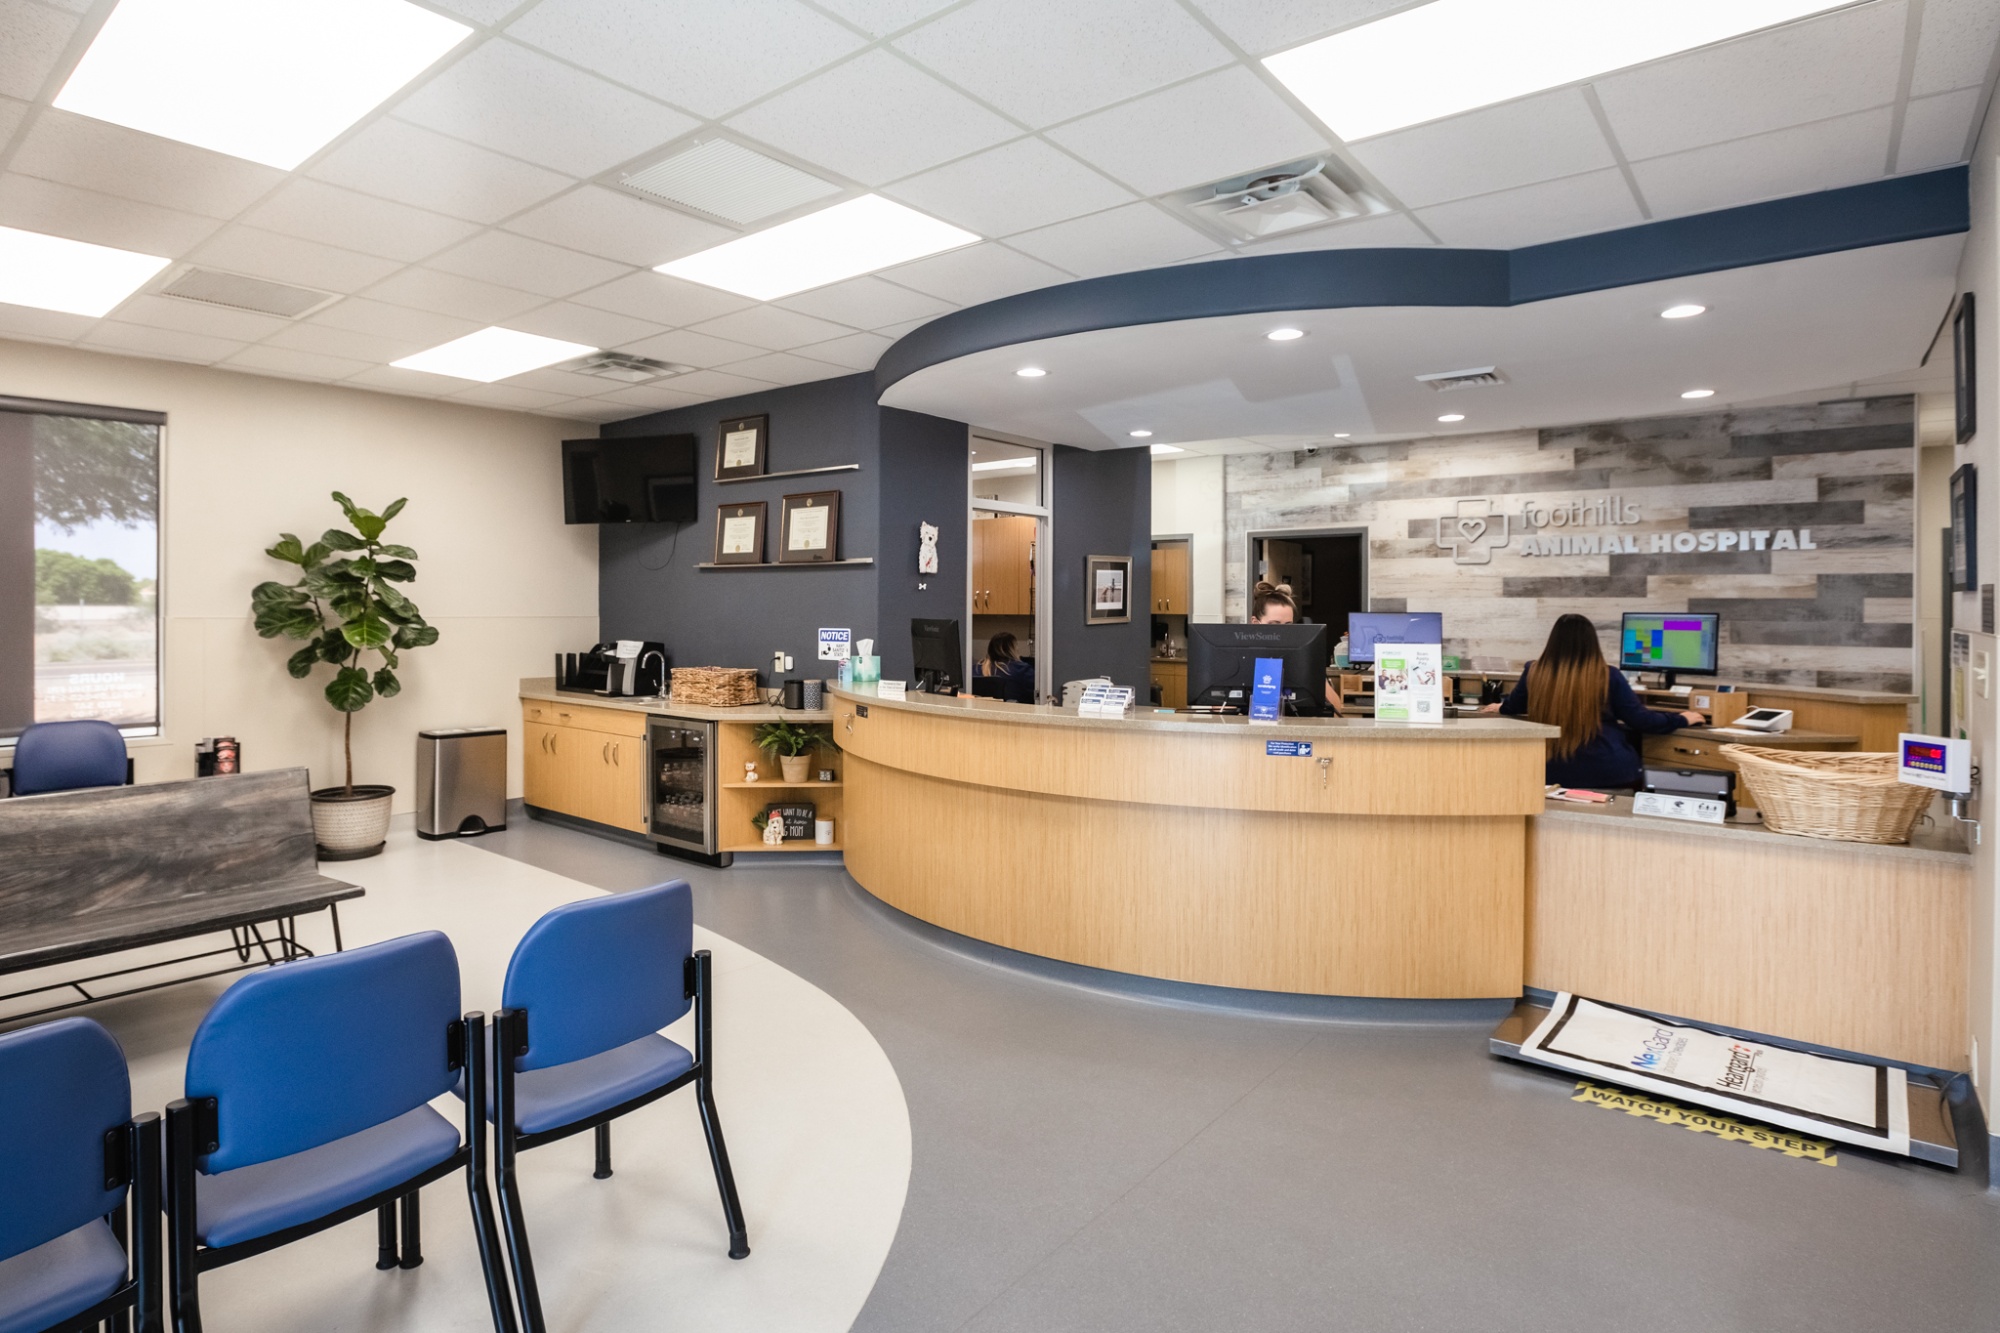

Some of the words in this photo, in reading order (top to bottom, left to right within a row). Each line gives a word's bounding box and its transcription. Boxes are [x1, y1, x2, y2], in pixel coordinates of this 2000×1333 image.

[1521, 496, 1641, 529] foothills
[1520, 534, 1639, 557] ANIMAL
[1650, 529, 1817, 553] HOSPITAL
[820, 631, 849, 641] NOTICE
[1234, 631, 1281, 640] ViewSonic
[782, 808, 796, 817] WANT
[789, 825, 804, 837] MOM
[1631, 1027, 1674, 1070] NexGard
[1716, 1046, 1756, 1090] Heartgard
[1592, 1090, 1671, 1117] WATCH
[1678, 1111, 1745, 1136] YOUR
[1752, 1131, 1819, 1152] STEP
